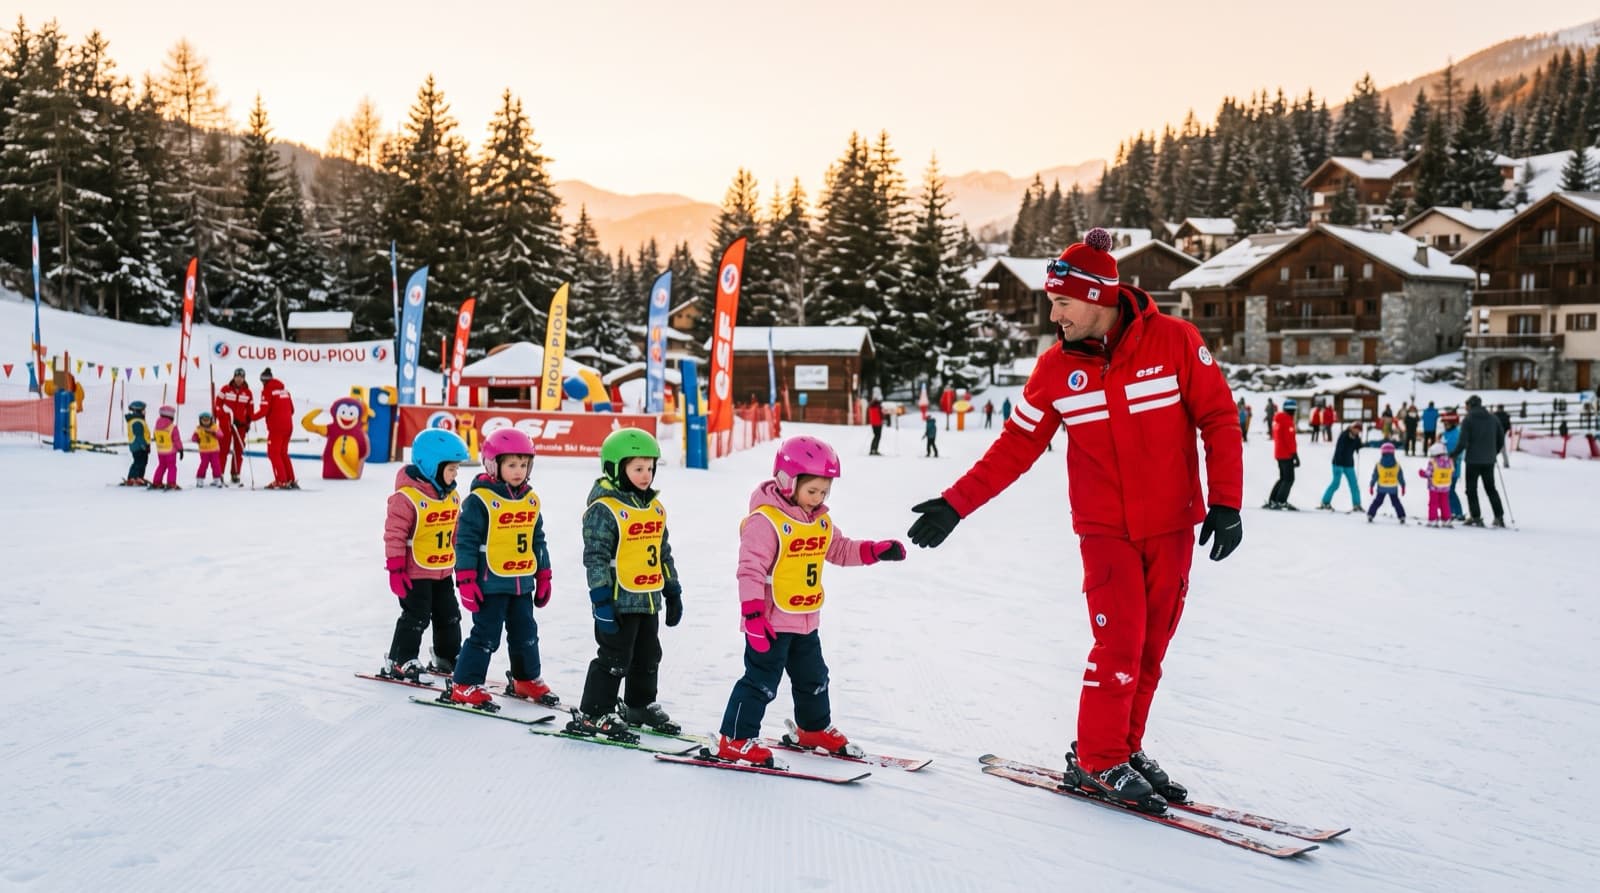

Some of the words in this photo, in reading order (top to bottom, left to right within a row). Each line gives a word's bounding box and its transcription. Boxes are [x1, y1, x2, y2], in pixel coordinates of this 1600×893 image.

[238, 345, 277, 361] CLUB
[283, 347, 366, 363] PIOU-PIOU
[547, 304, 564, 398] PIOU-PIOU
[517, 533, 528, 554] 5
[646, 544, 658, 567] 3
[806, 563, 817, 587] 5
